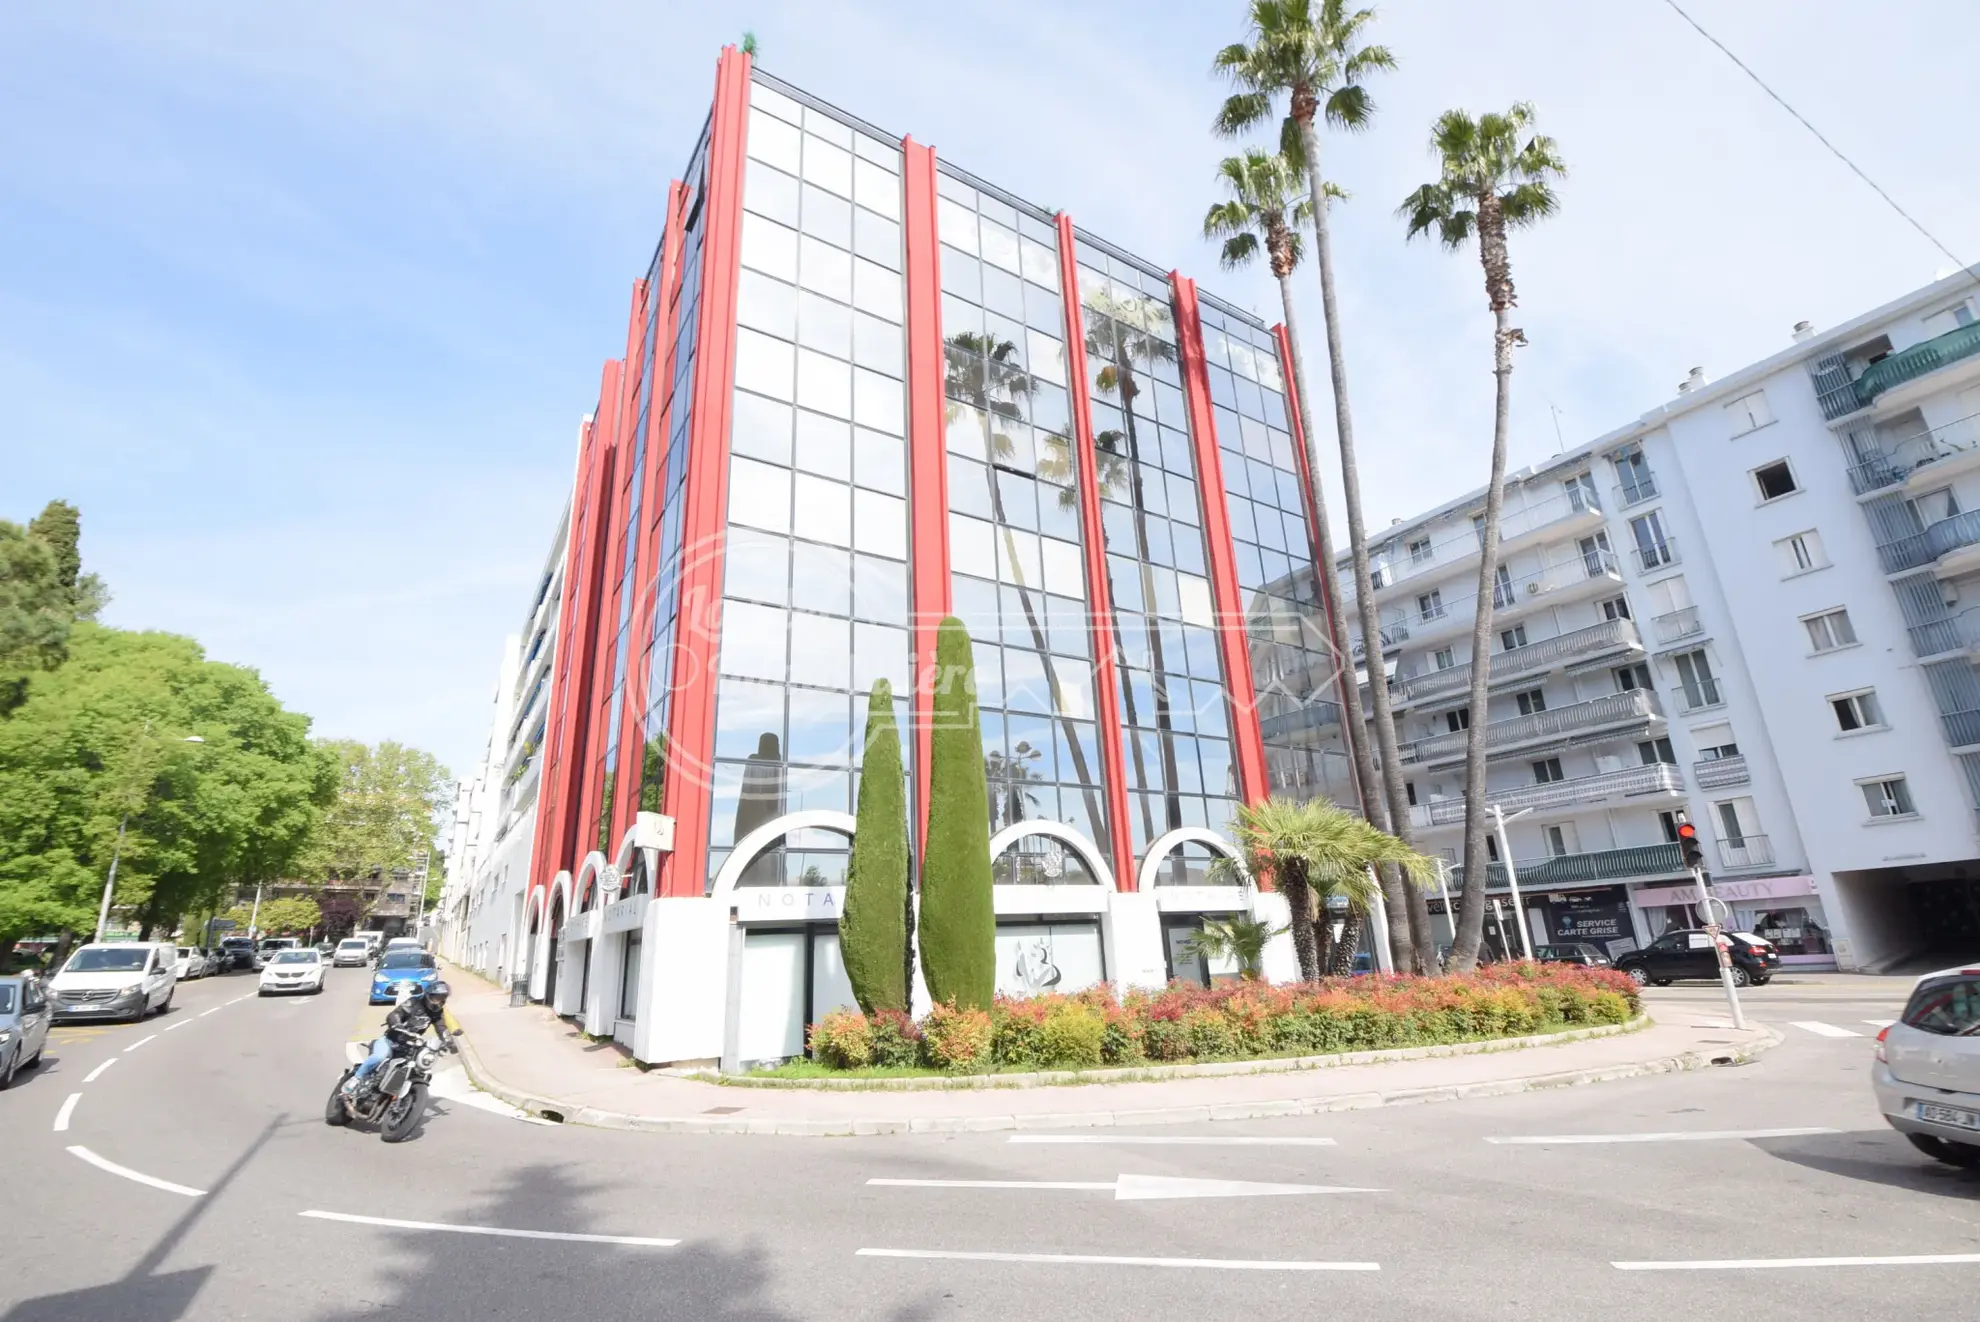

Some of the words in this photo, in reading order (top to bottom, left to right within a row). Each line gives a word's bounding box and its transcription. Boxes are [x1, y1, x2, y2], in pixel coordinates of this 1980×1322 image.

[1576, 918, 1617, 928] SERVICE
[1557, 928, 1588, 936] CARTE
[1589, 926, 1619, 935] GRISE
